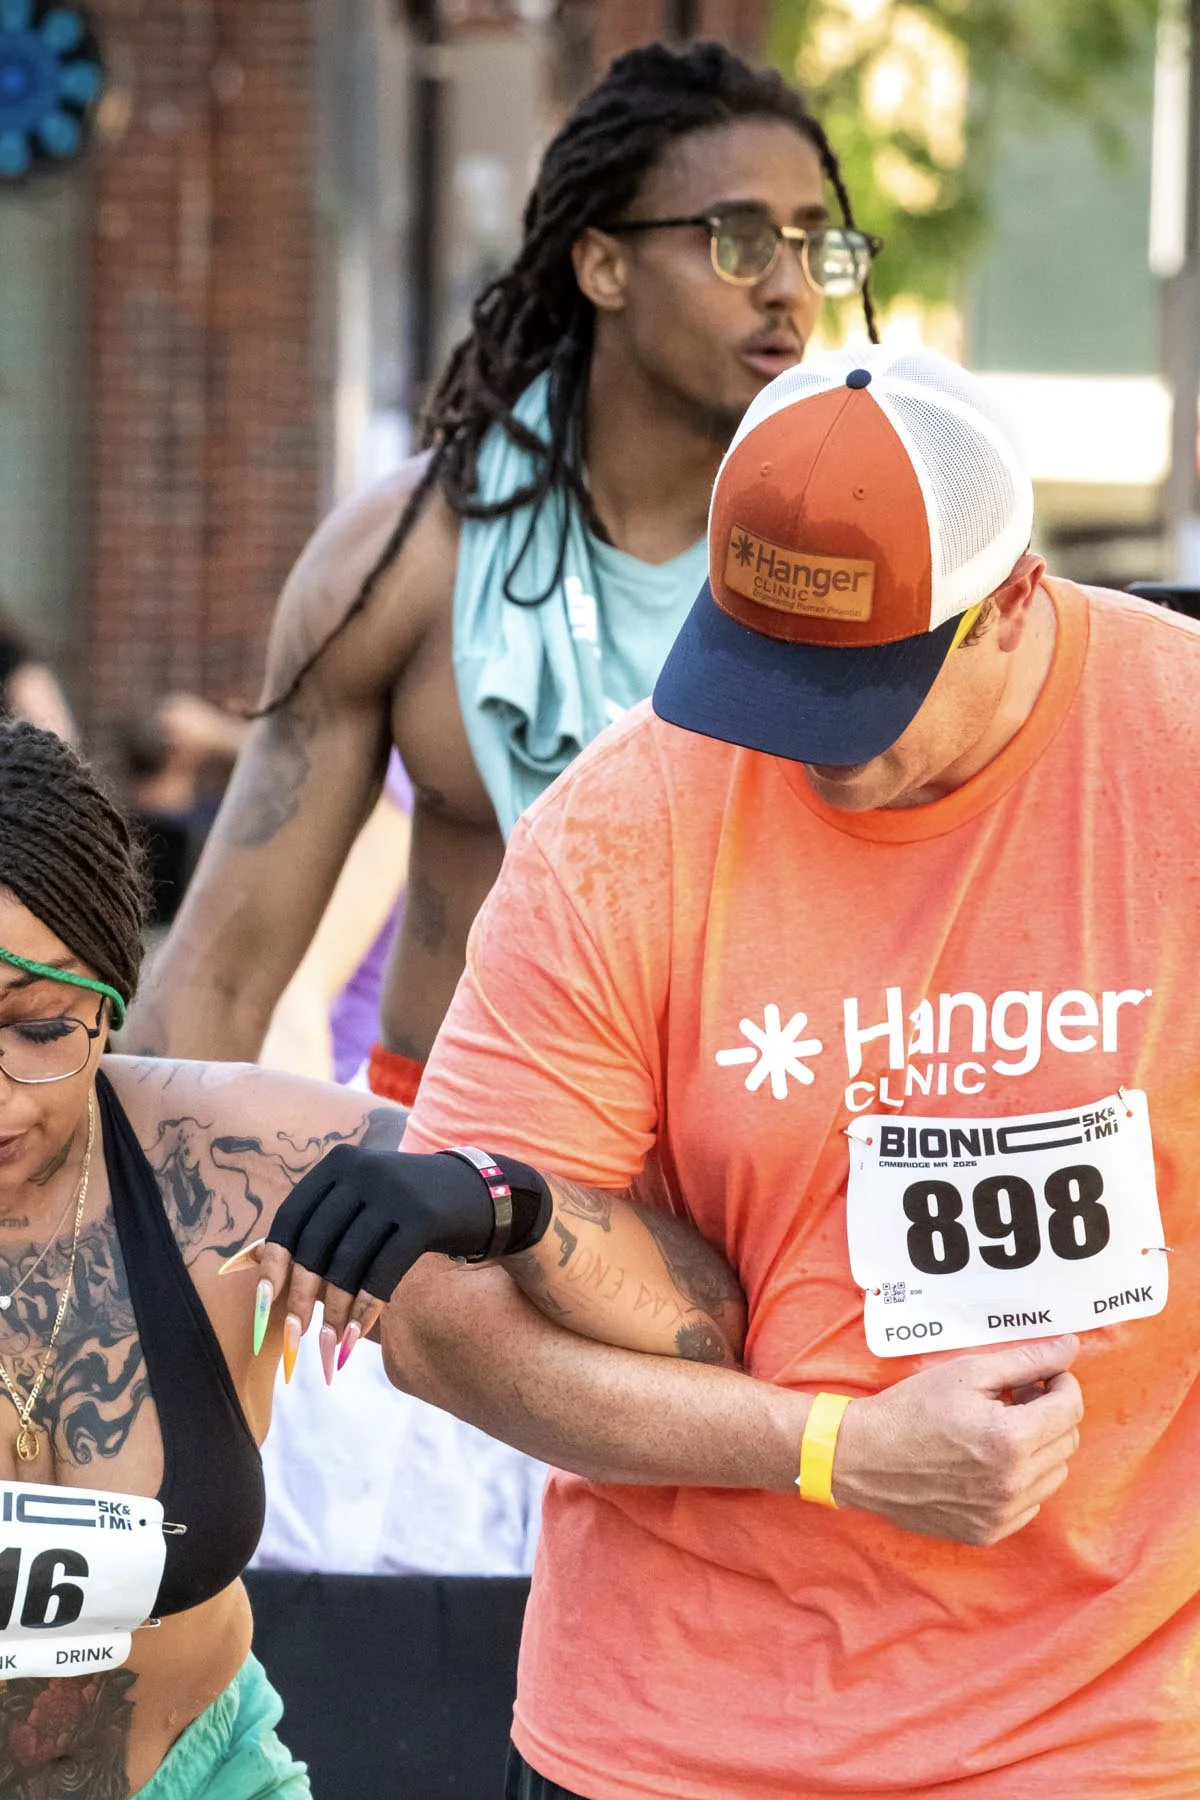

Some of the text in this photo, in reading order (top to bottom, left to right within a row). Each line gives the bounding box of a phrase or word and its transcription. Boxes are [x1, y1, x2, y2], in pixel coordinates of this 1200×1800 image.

[753, 576, 808, 601] CLINIC
[756, 543, 872, 598] Hanger
[843, 986, 1152, 1079] Hanger
[845, 1062, 986, 1112] CLNIC
[879, 1107, 1116, 1158] BIONIC 5K&
[879, 1160, 930, 1168] CAMBRIDGE
[902, 1164, 1110, 1275] 898
[885, 1286, 1154, 1342] FOOD DRINK DRINK
[98, 1500, 132, 1516] 5K&
[56, 1646, 114, 1665] DRINK
